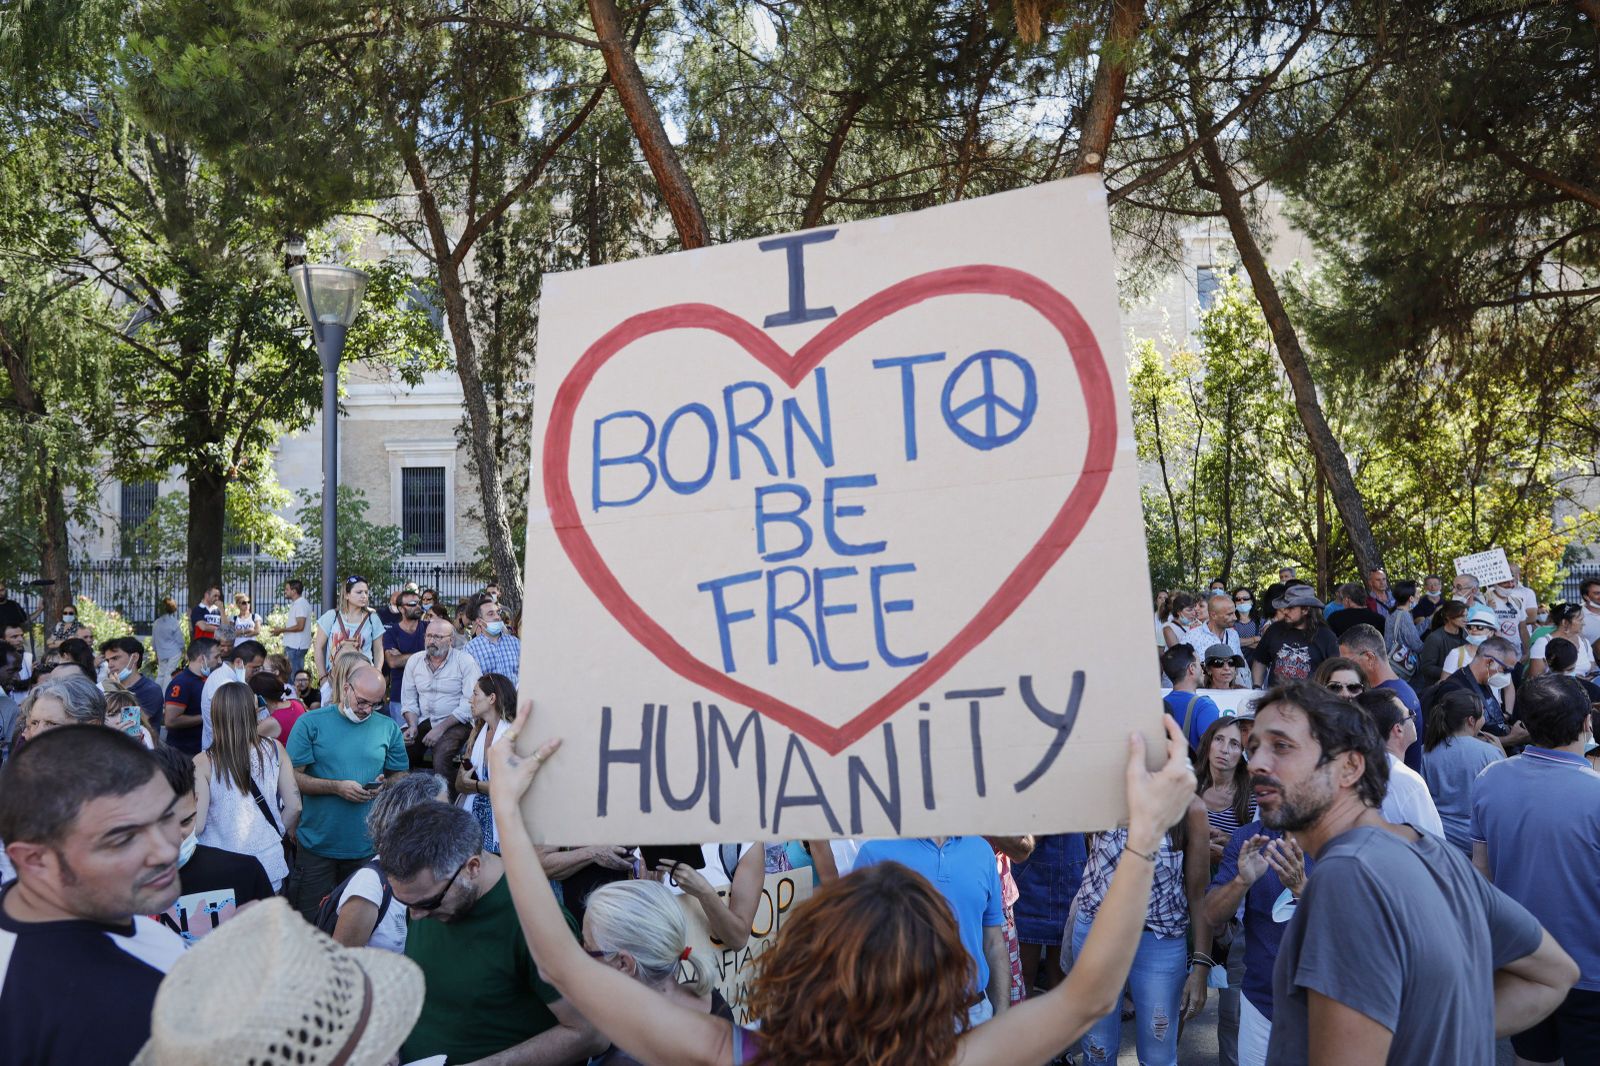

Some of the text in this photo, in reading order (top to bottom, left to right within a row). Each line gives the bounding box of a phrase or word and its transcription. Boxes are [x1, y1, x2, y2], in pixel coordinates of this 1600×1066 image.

[758, 228, 839, 328] I
[592, 366, 834, 512] BORN
[754, 473, 887, 562] BE
[697, 563, 929, 673] FREE
[171, 685, 180, 697] 3
